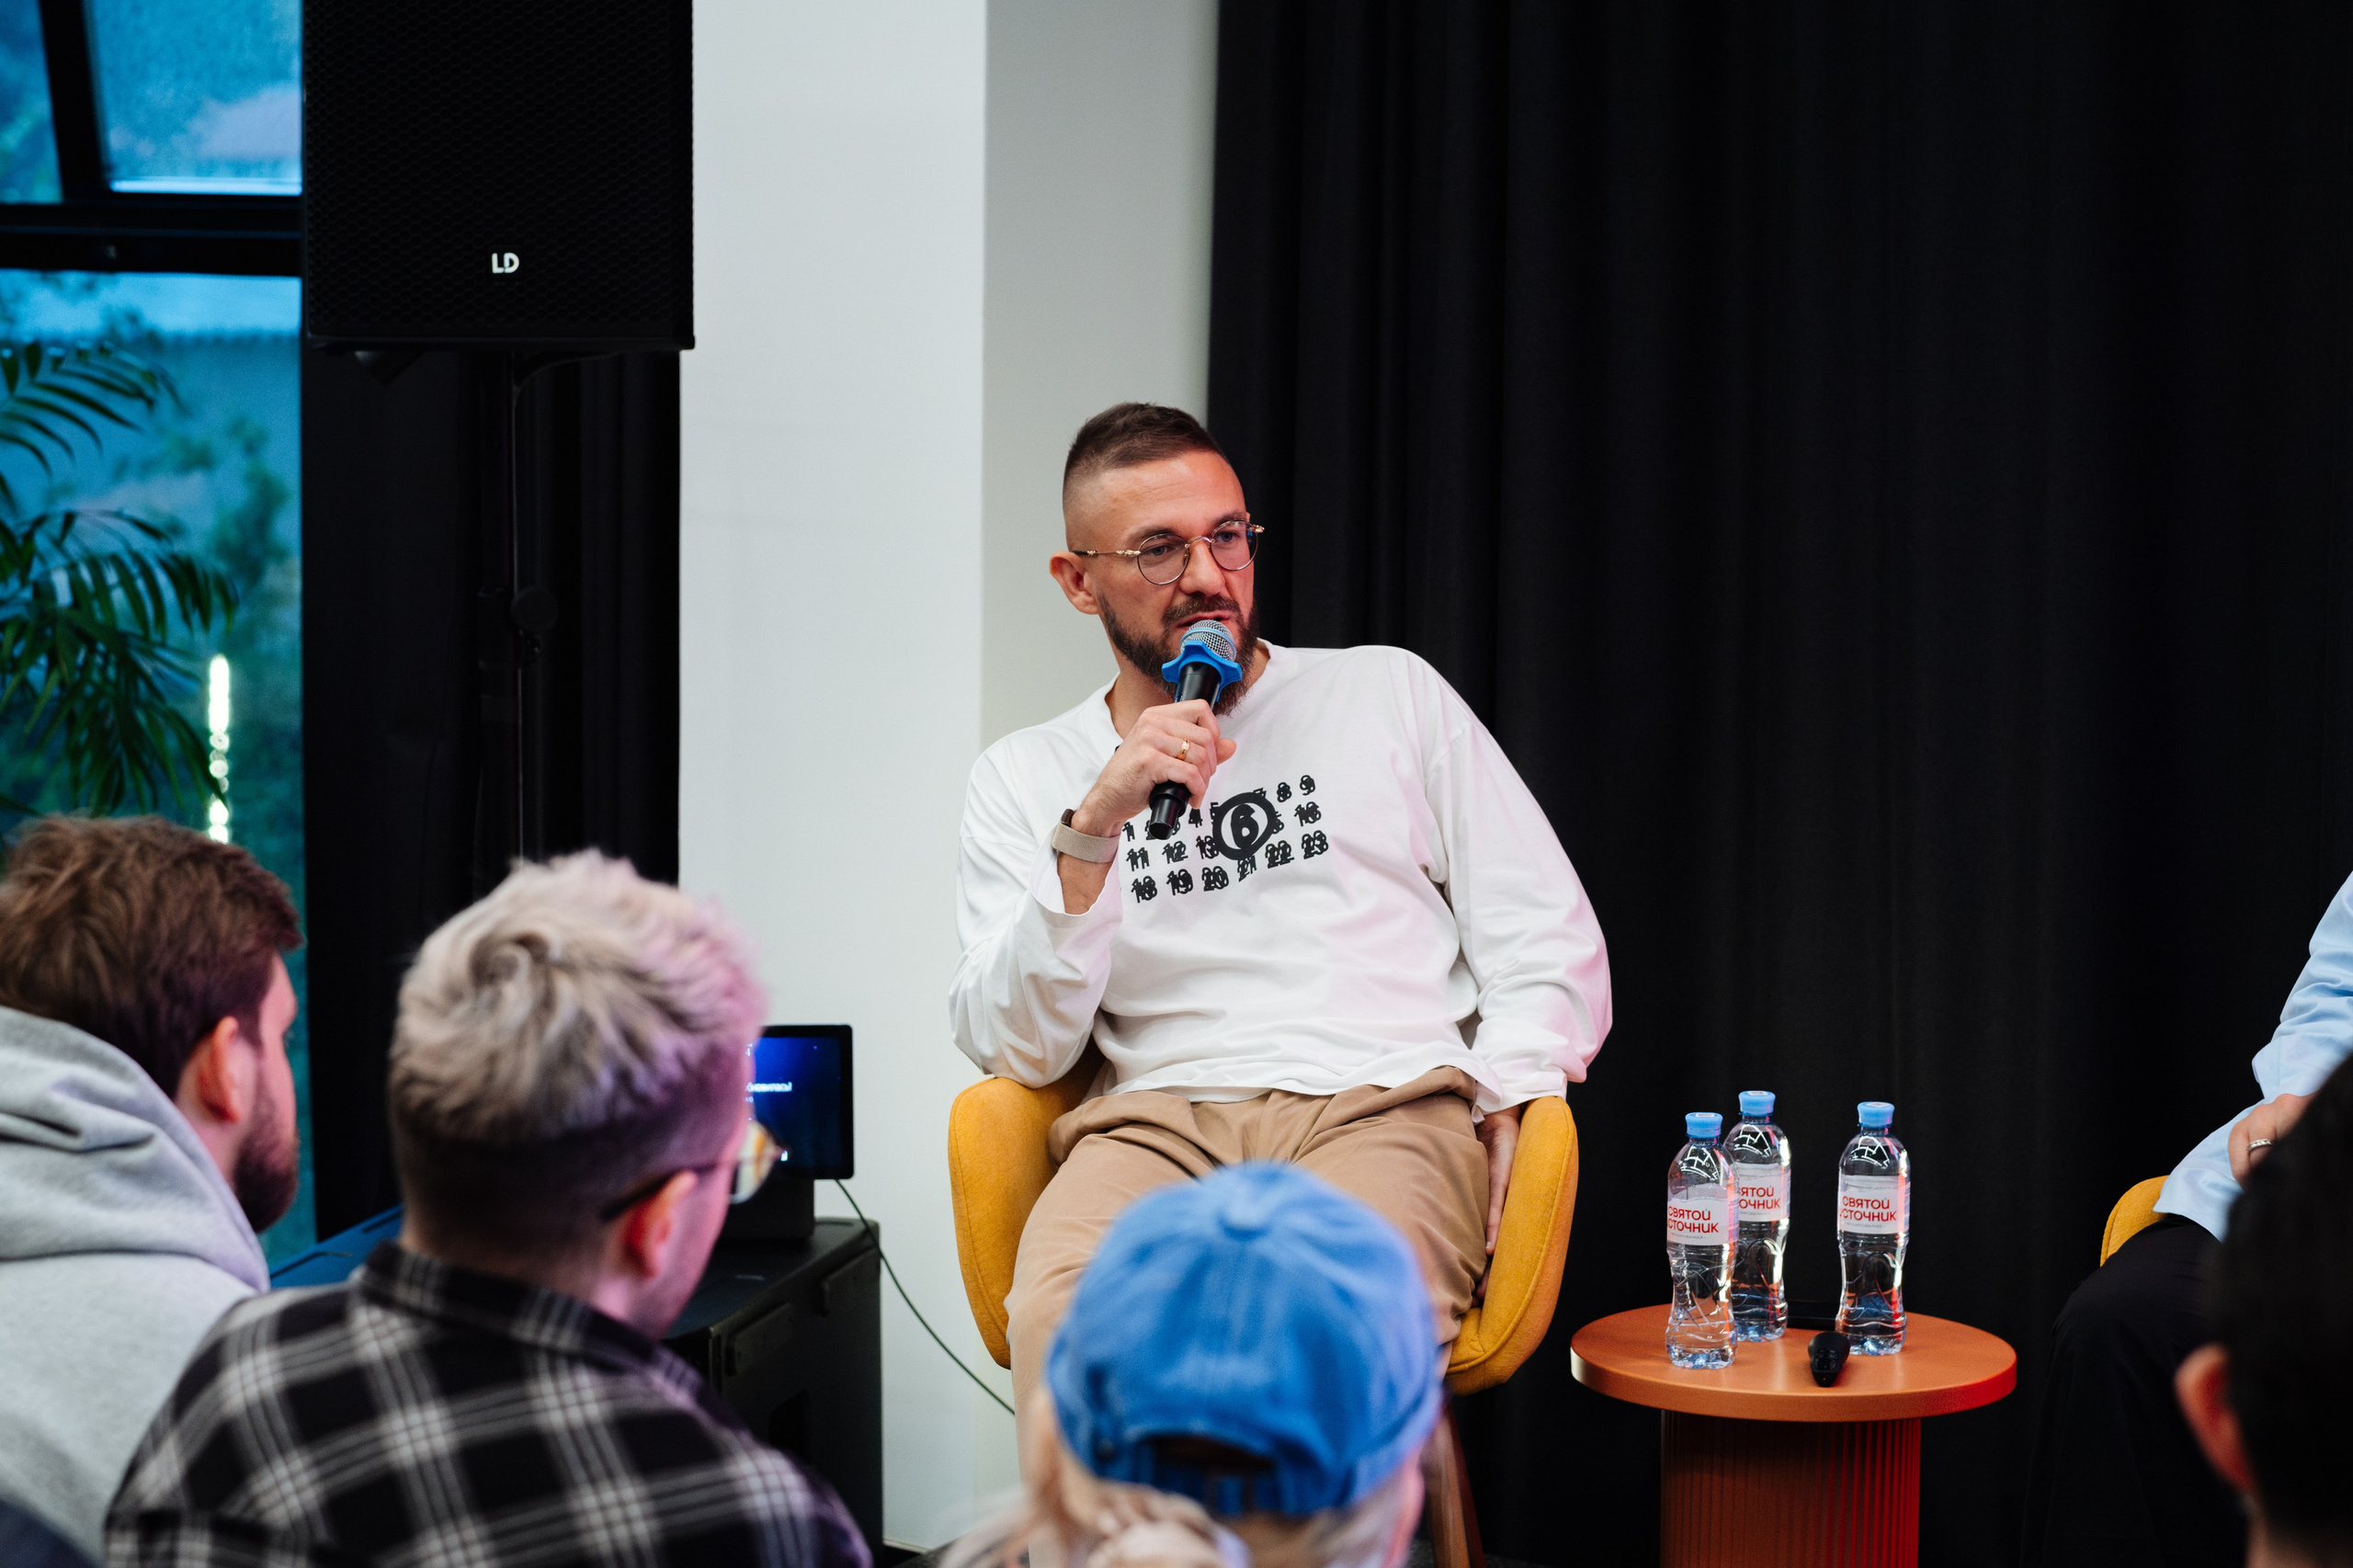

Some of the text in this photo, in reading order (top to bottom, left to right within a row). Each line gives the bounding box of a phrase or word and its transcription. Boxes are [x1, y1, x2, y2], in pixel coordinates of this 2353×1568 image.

[492, 252, 520, 274] LD
[1230, 803, 1259, 850] 6
[1277, 782, 1292, 802] 8
[1300, 775, 1315, 796] 9
[1126, 847, 1150, 872] 11
[1162, 840, 1188, 864] 12
[1166, 869, 1194, 895] 19
[1201, 866, 1229, 892] 20
[1265, 840, 1295, 869] 22
[1739, 1185, 1775, 1198] ЯТОЙ
[1738, 1199, 1781, 1210] ОЧНИК
[1842, 1195, 1891, 1210] СВЯТОЙ
[1667, 1218, 1719, 1233] СТОЧНИК
